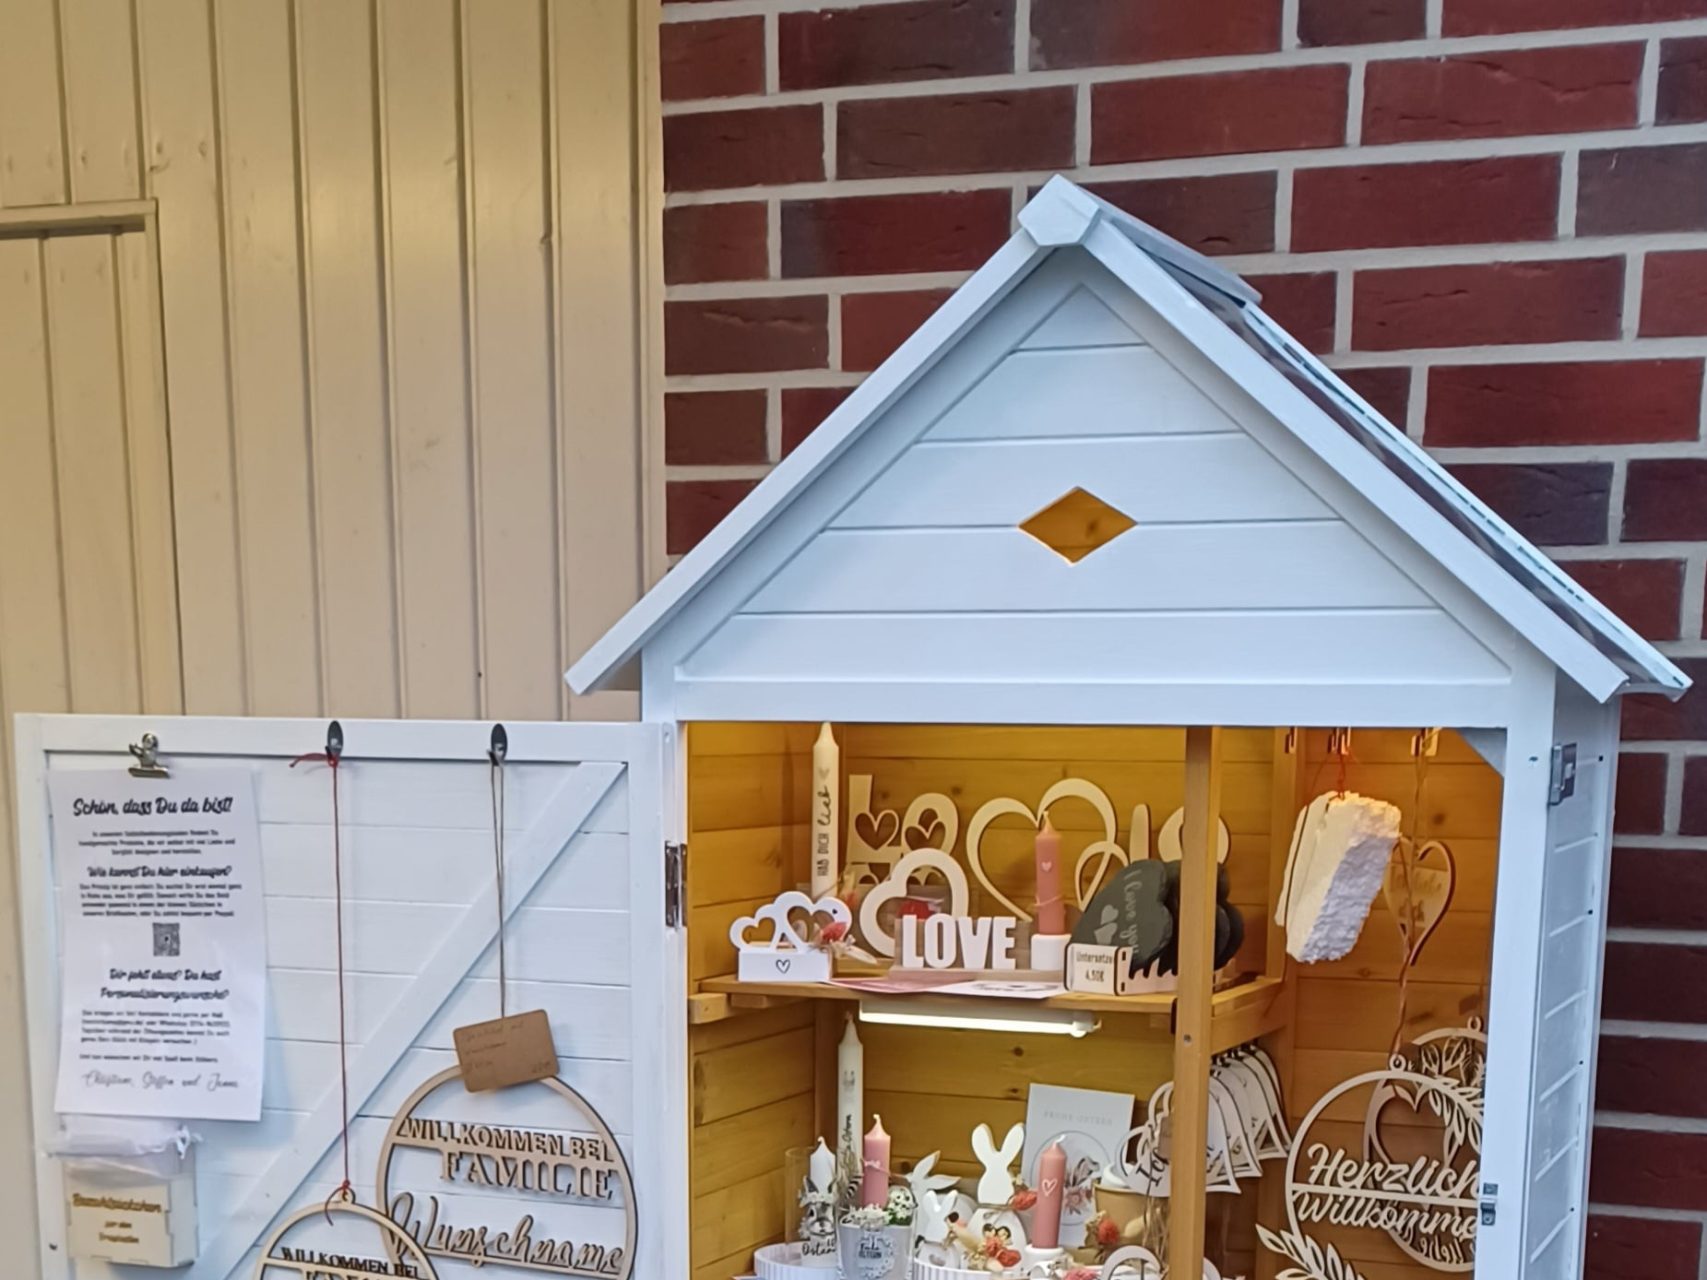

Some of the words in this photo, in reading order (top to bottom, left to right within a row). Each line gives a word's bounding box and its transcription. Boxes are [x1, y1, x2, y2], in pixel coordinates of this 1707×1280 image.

[73, 797, 118, 816] Schön,
[122, 799, 152, 816] dass
[155, 797, 178, 815] Du
[181, 797, 199, 814] da
[202, 796, 233, 815] bist!
[817, 785, 831, 826] lieb
[817, 833, 829, 855] DICH
[1123, 880, 1143, 920] love
[902, 913, 1017, 969] LOVE
[1119, 923, 1140, 955] you
[398, 1118, 571, 1158] WILLKOMMEN
[570, 1136, 616, 1163] BEI
[440, 1150, 619, 1200] FAMILIE
[1307, 1142, 1480, 1200] Herzlich
[389, 1191, 625, 1277] Wunschname
[1293, 1191, 1479, 1238] Willkomme
[281, 1246, 389, 1275] WILLKOMMEN
[393, 1262, 421, 1279] BEI
